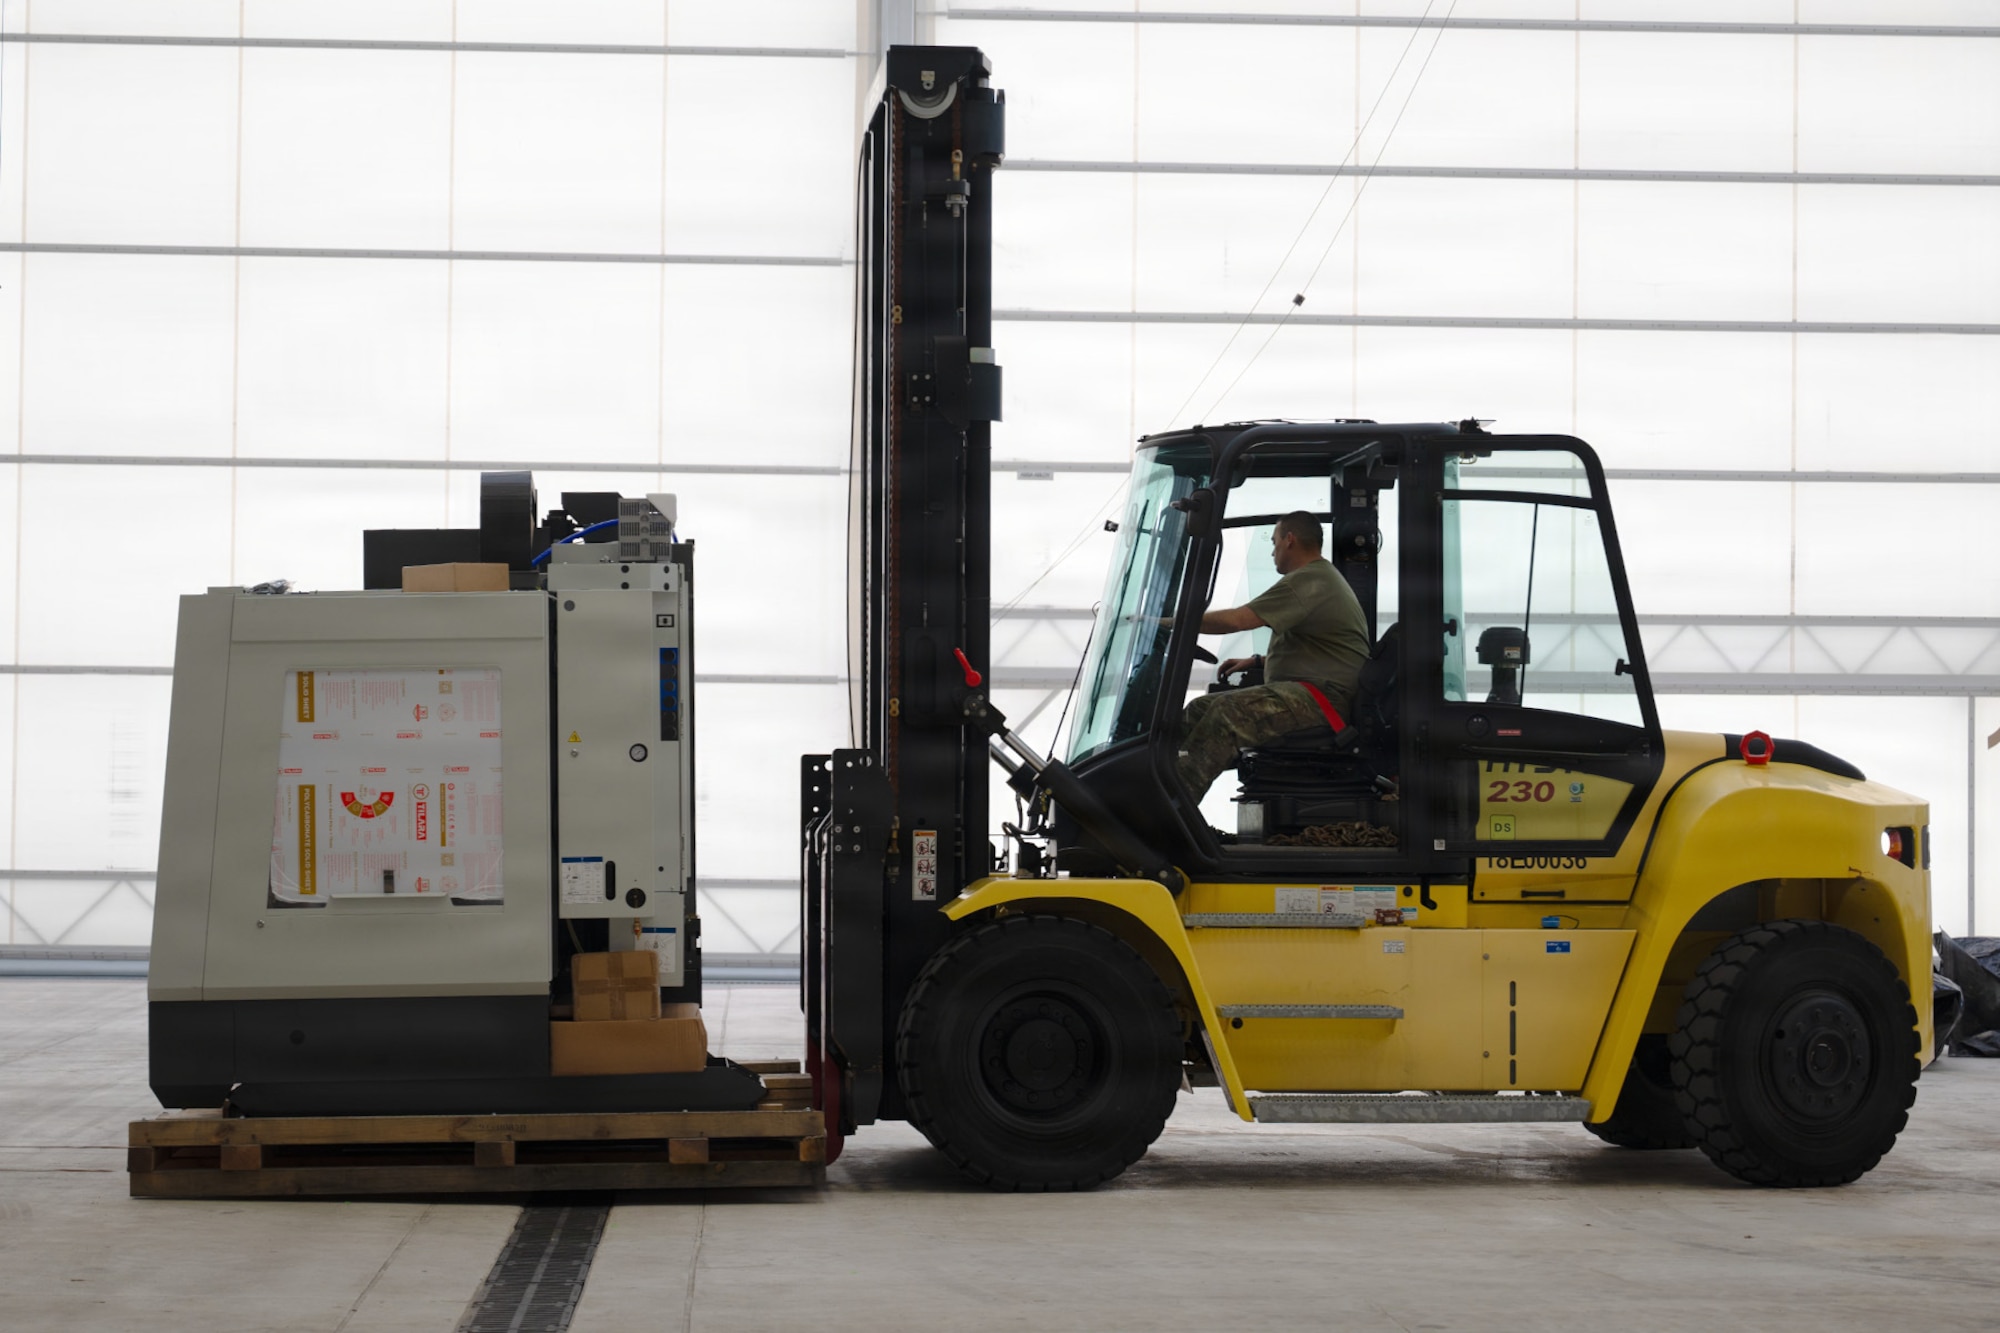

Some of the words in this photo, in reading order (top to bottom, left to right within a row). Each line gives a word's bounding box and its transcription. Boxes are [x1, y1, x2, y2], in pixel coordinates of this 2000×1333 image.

[1486, 780, 1555, 803] 230
[303, 788, 311, 847] POLYCARBONATE
[417, 803, 426, 840] TILARA
[1494, 823, 1511, 832] DS
[304, 870, 312, 891] SHEET
